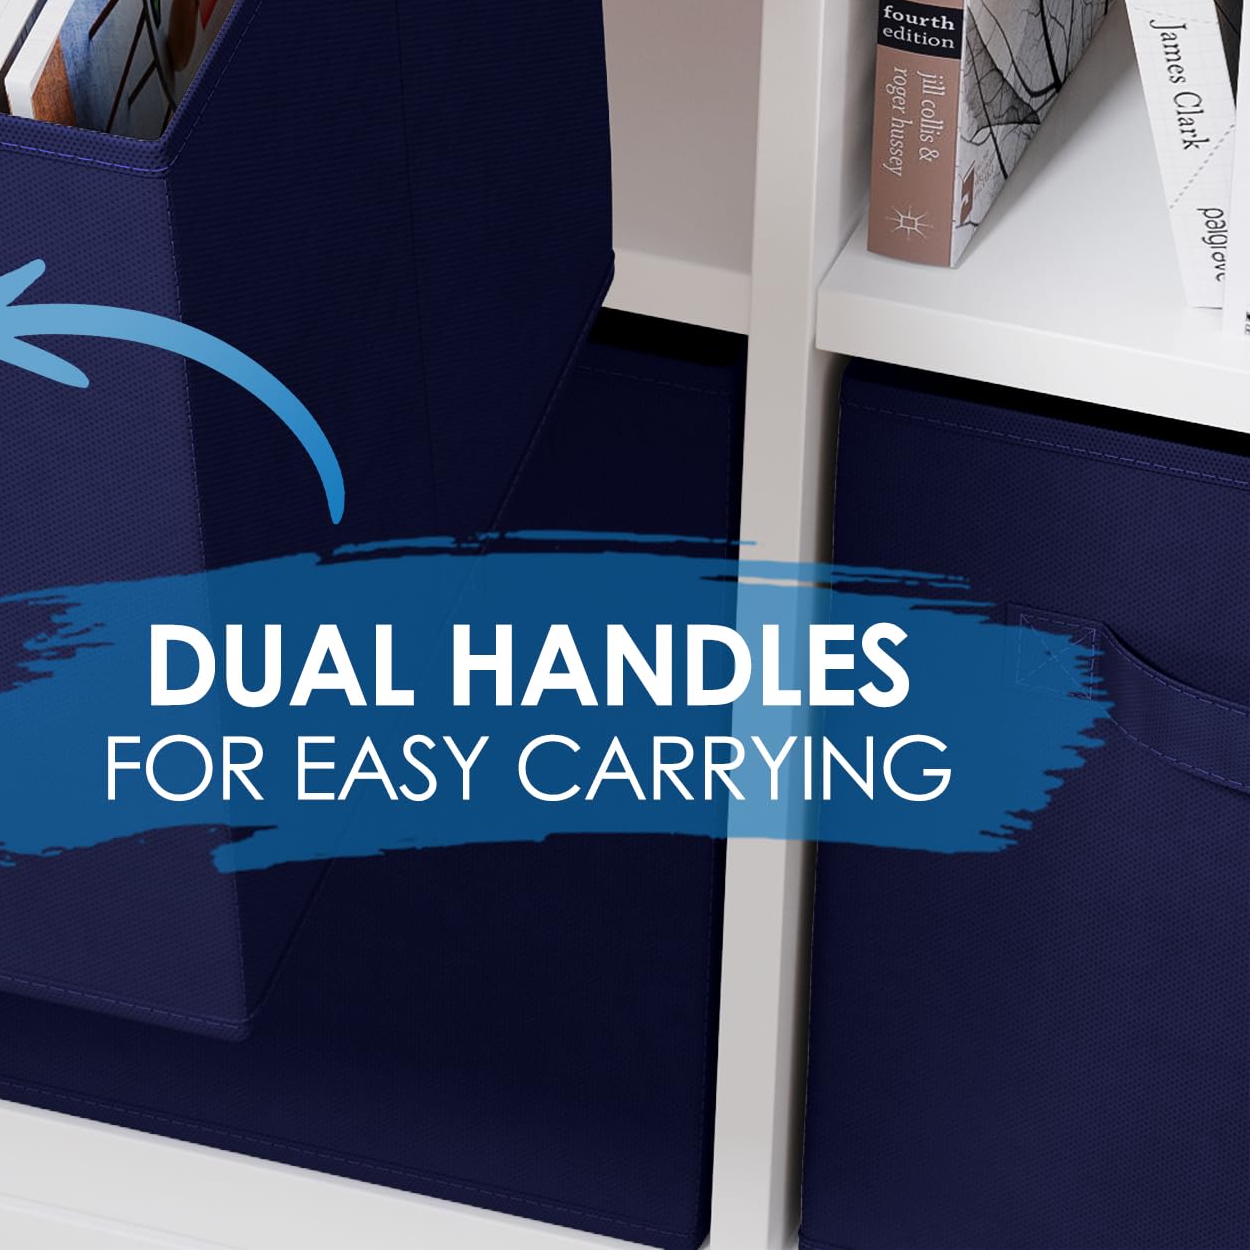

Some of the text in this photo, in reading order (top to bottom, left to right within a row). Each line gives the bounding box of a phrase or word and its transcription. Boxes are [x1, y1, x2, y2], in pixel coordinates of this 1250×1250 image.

[882, 26, 956, 49] edition
[883, 5, 956, 31] fourth
[882, 66, 913, 177] roger hussey
[917, 70, 946, 162] jill collis &
[1150, 18, 1211, 151] James Clark
